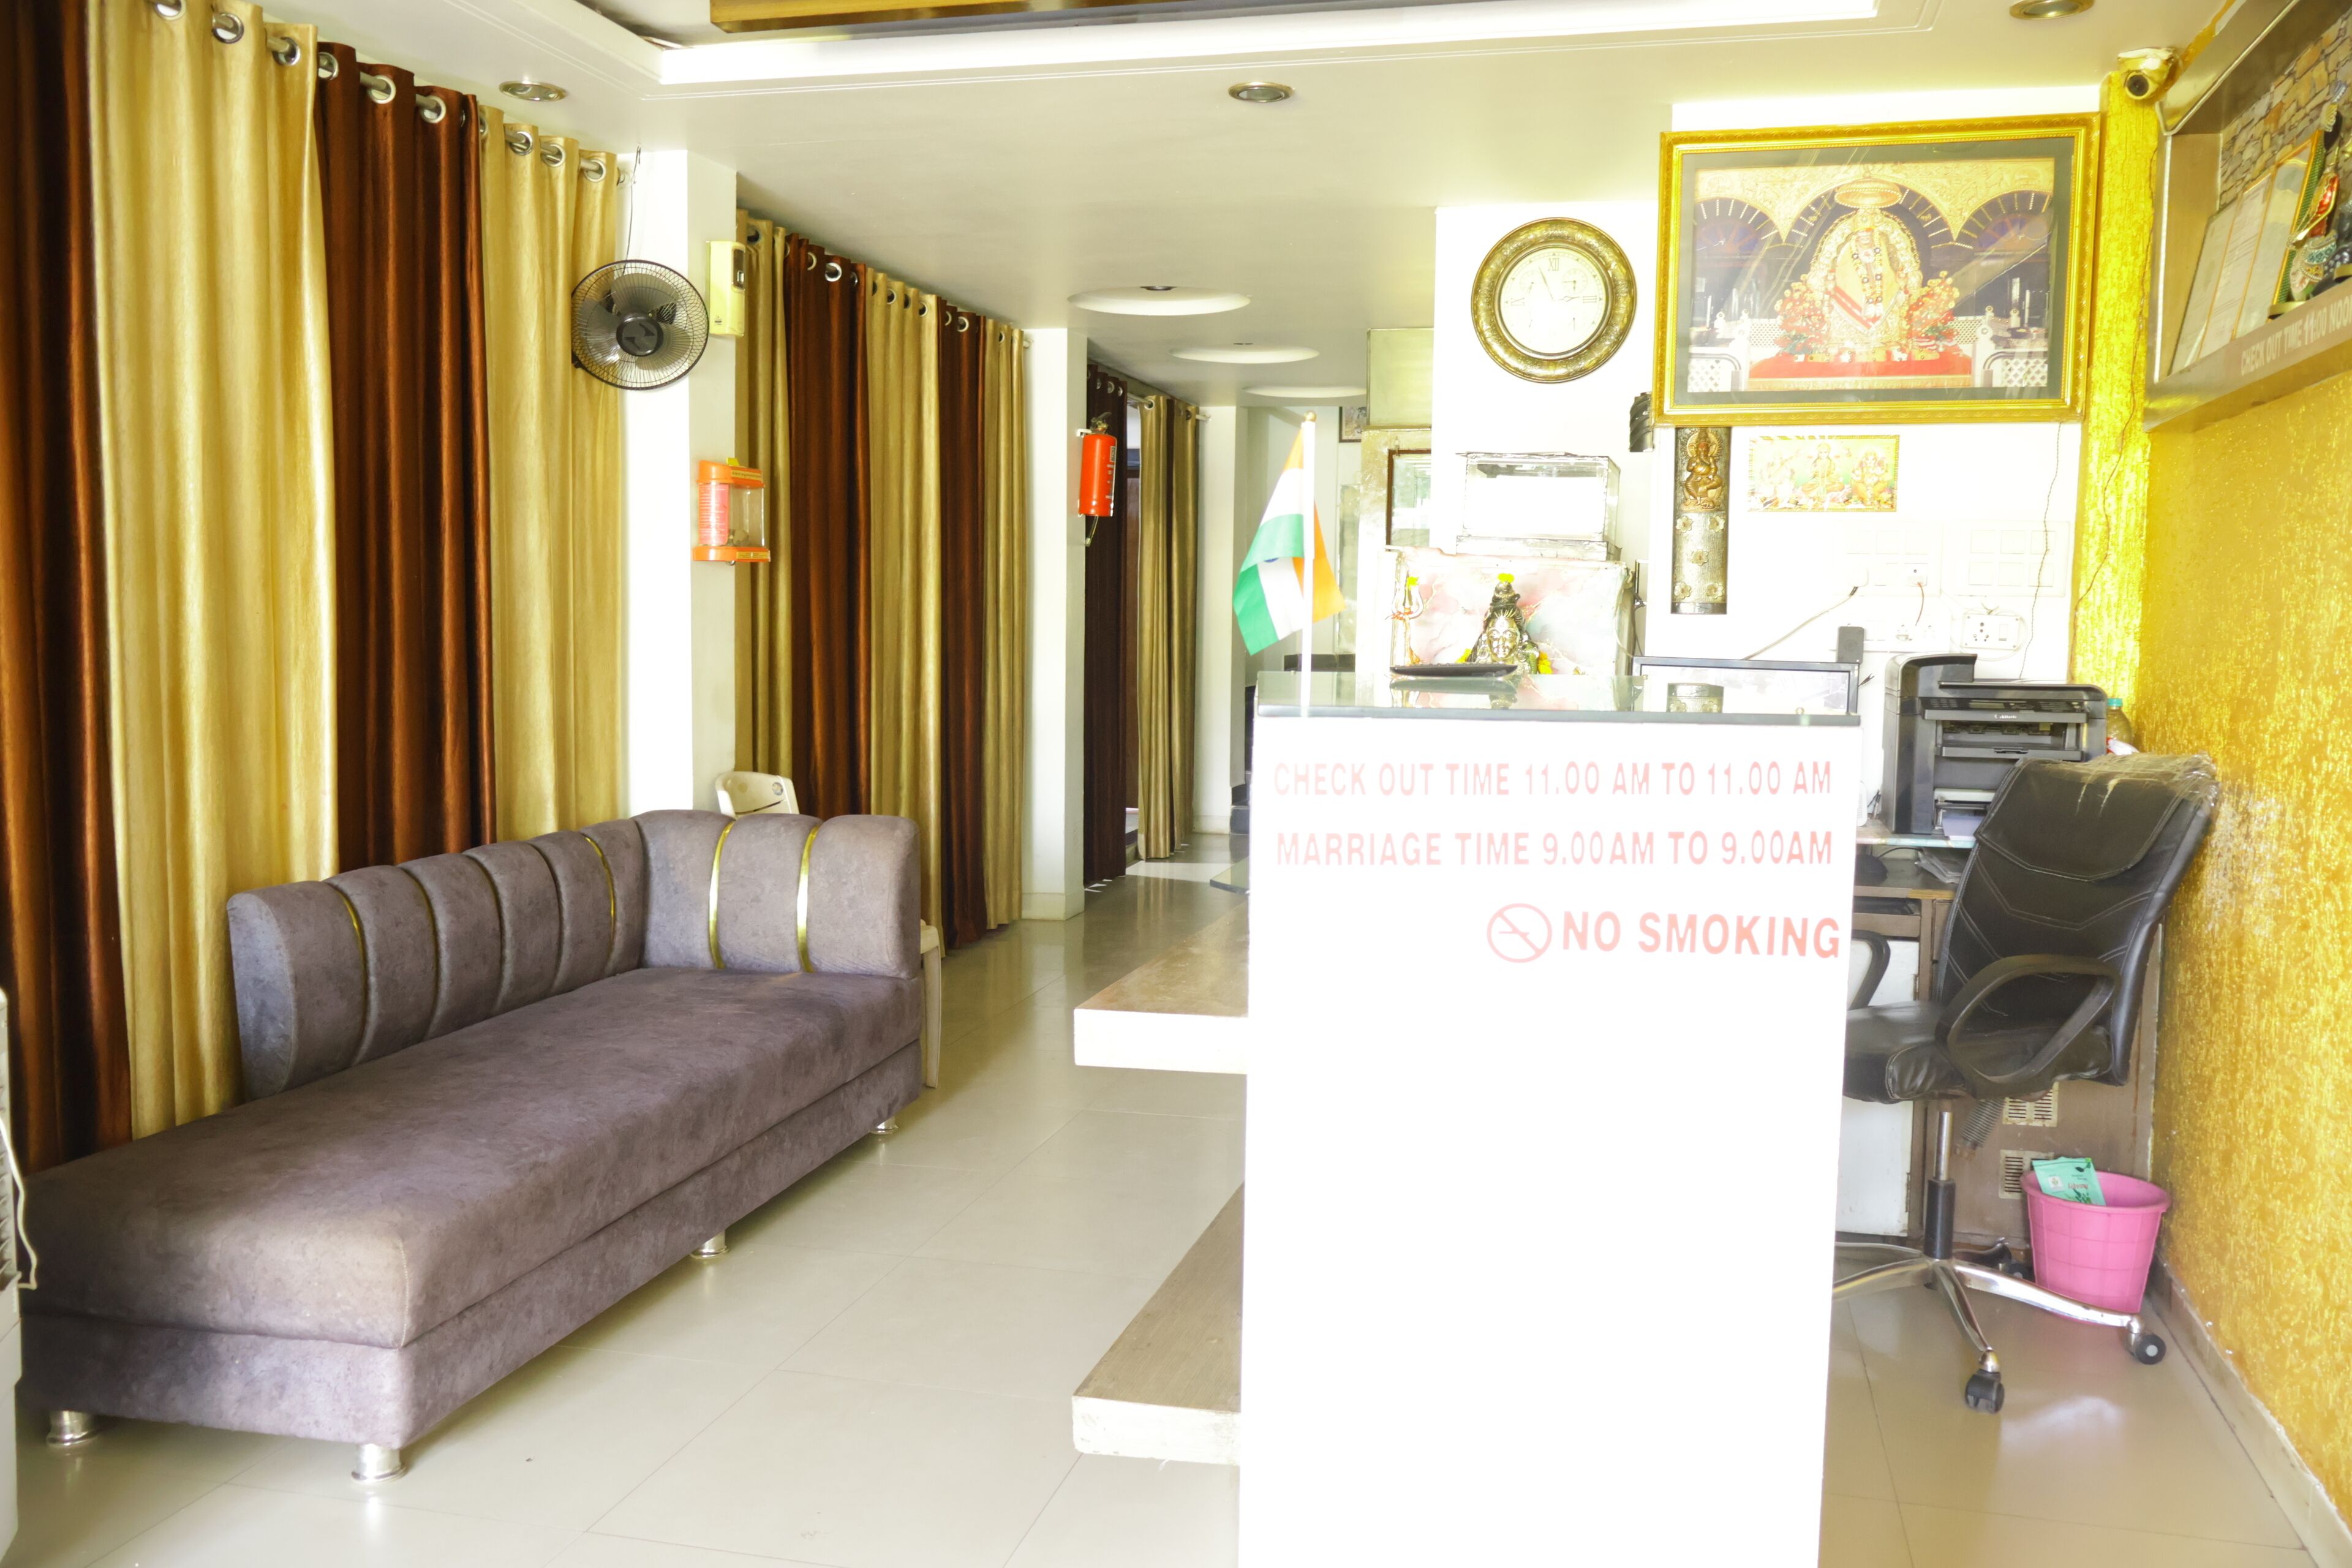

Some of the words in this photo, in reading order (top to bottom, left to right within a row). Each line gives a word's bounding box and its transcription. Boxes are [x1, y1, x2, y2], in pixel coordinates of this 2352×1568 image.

[2241, 340, 2265, 376] CHECK
[2266, 331, 2283, 363] OUT
[2283, 318, 2304, 354] TIME
[1274, 764, 1366, 796] CHECK
[1379, 764, 1435, 796] OUT
[1446, 764, 1510, 796] TIME
[1525, 762, 1601, 796] 11.00
[1612, 763, 1651, 795] AM
[1662, 763, 1696, 796] TO
[1708, 762, 1782, 796] 11.00
[1792, 761, 1832, 795] AM
[1276, 833, 1442, 866] MARRIAGE
[1455, 833, 1530, 865] TIME
[1668, 831, 1709, 866] TO
[1562, 911, 1622, 952] NO
[1638, 912, 1841, 960] SMOKING
